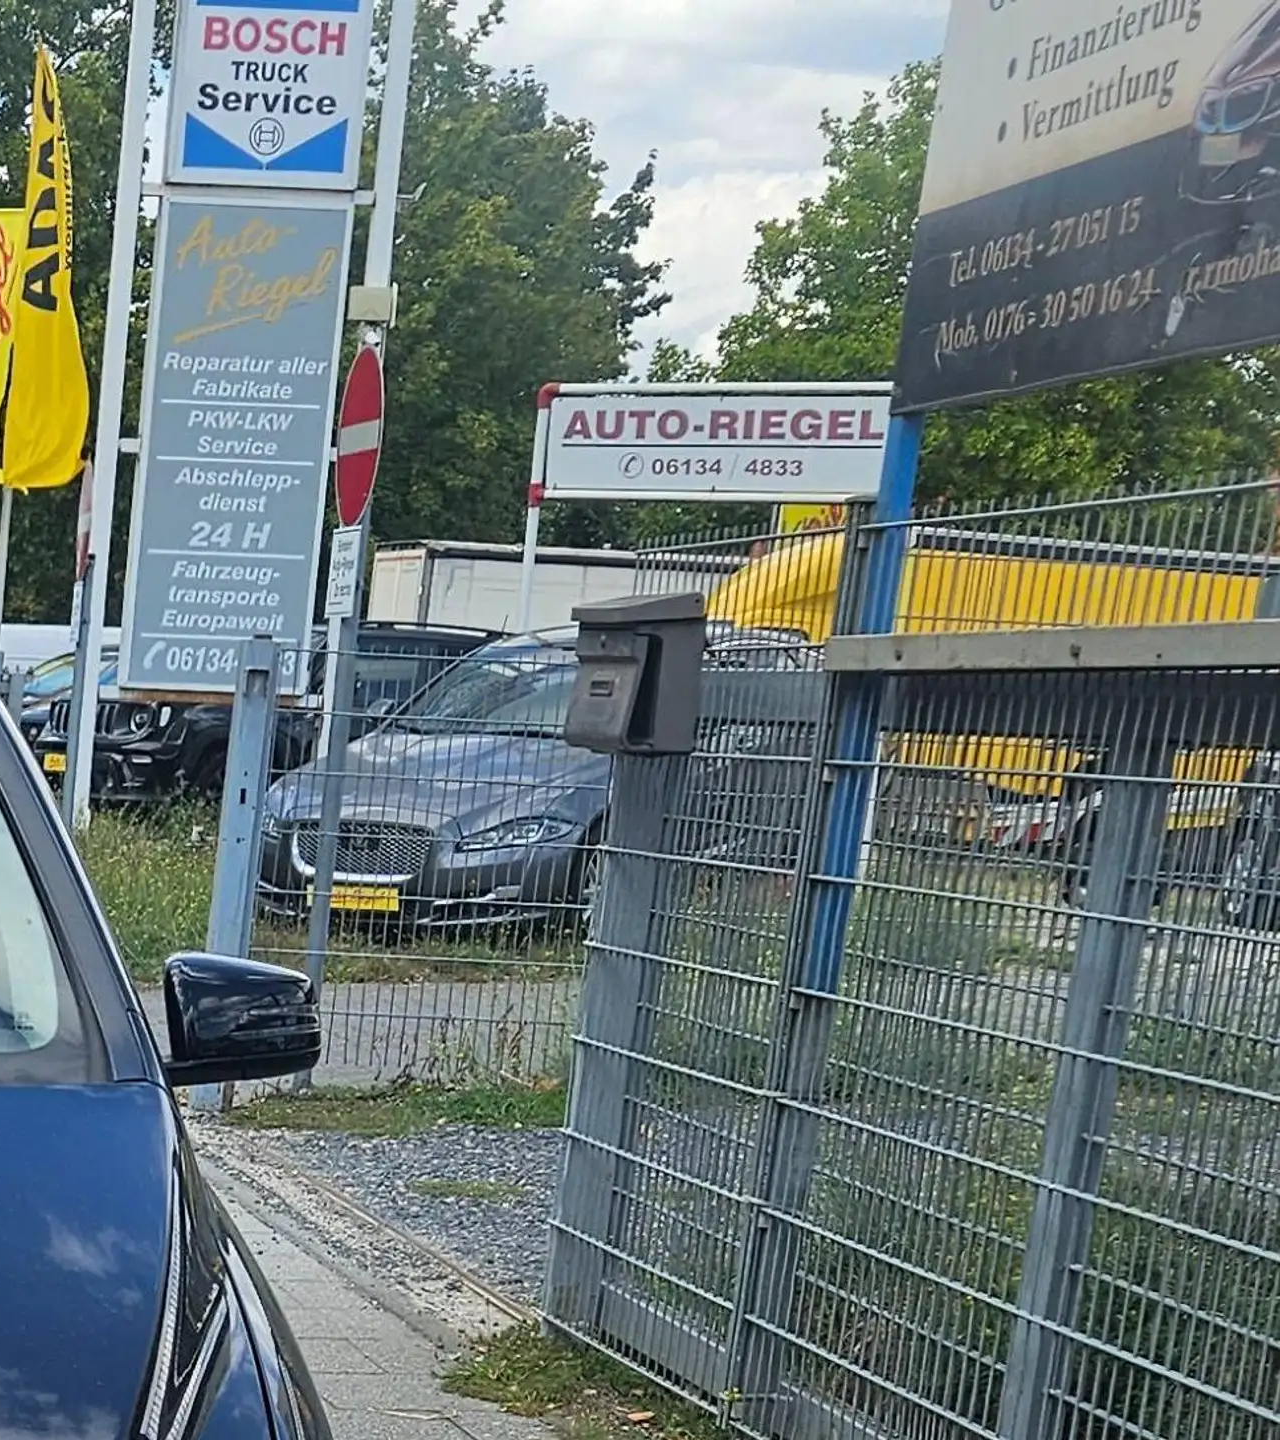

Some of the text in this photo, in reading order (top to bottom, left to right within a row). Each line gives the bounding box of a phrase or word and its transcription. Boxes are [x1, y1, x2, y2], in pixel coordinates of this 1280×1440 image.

[203, 16, 348, 56] BOSCH
[1026, 0, 1202, 82] Finanzierung
[231, 61, 309, 84] TRUCK
[197, 83, 337, 115] Service
[1022, 59, 1180, 143] Vermittlung
[950, 245, 977, 287] Tel.
[980, 228, 1036, 276] 06134
[206, 247, 339, 324] Riegel
[984, 300, 1028, 342] 0176
[1098, 273, 1126, 315] 16
[163, 351, 328, 376] Reparatur aller
[192, 378, 293, 399] Fabrikate
[187, 410, 294, 432] PKW-LKW
[562, 409, 885, 440] AUTO-RIEGEL
[197, 436, 279, 456] Service
[174, 467, 301, 492] Abschlepp-
[651, 457, 723, 476] 06134
[744, 458, 804, 477] 4833
[199, 493, 267, 513] dienst
[188, 521, 272, 550] 24 H
[171, 560, 281, 586] Fahrzeug-
[168, 585, 281, 608] transporte
[161, 609, 285, 632] Europaweit
